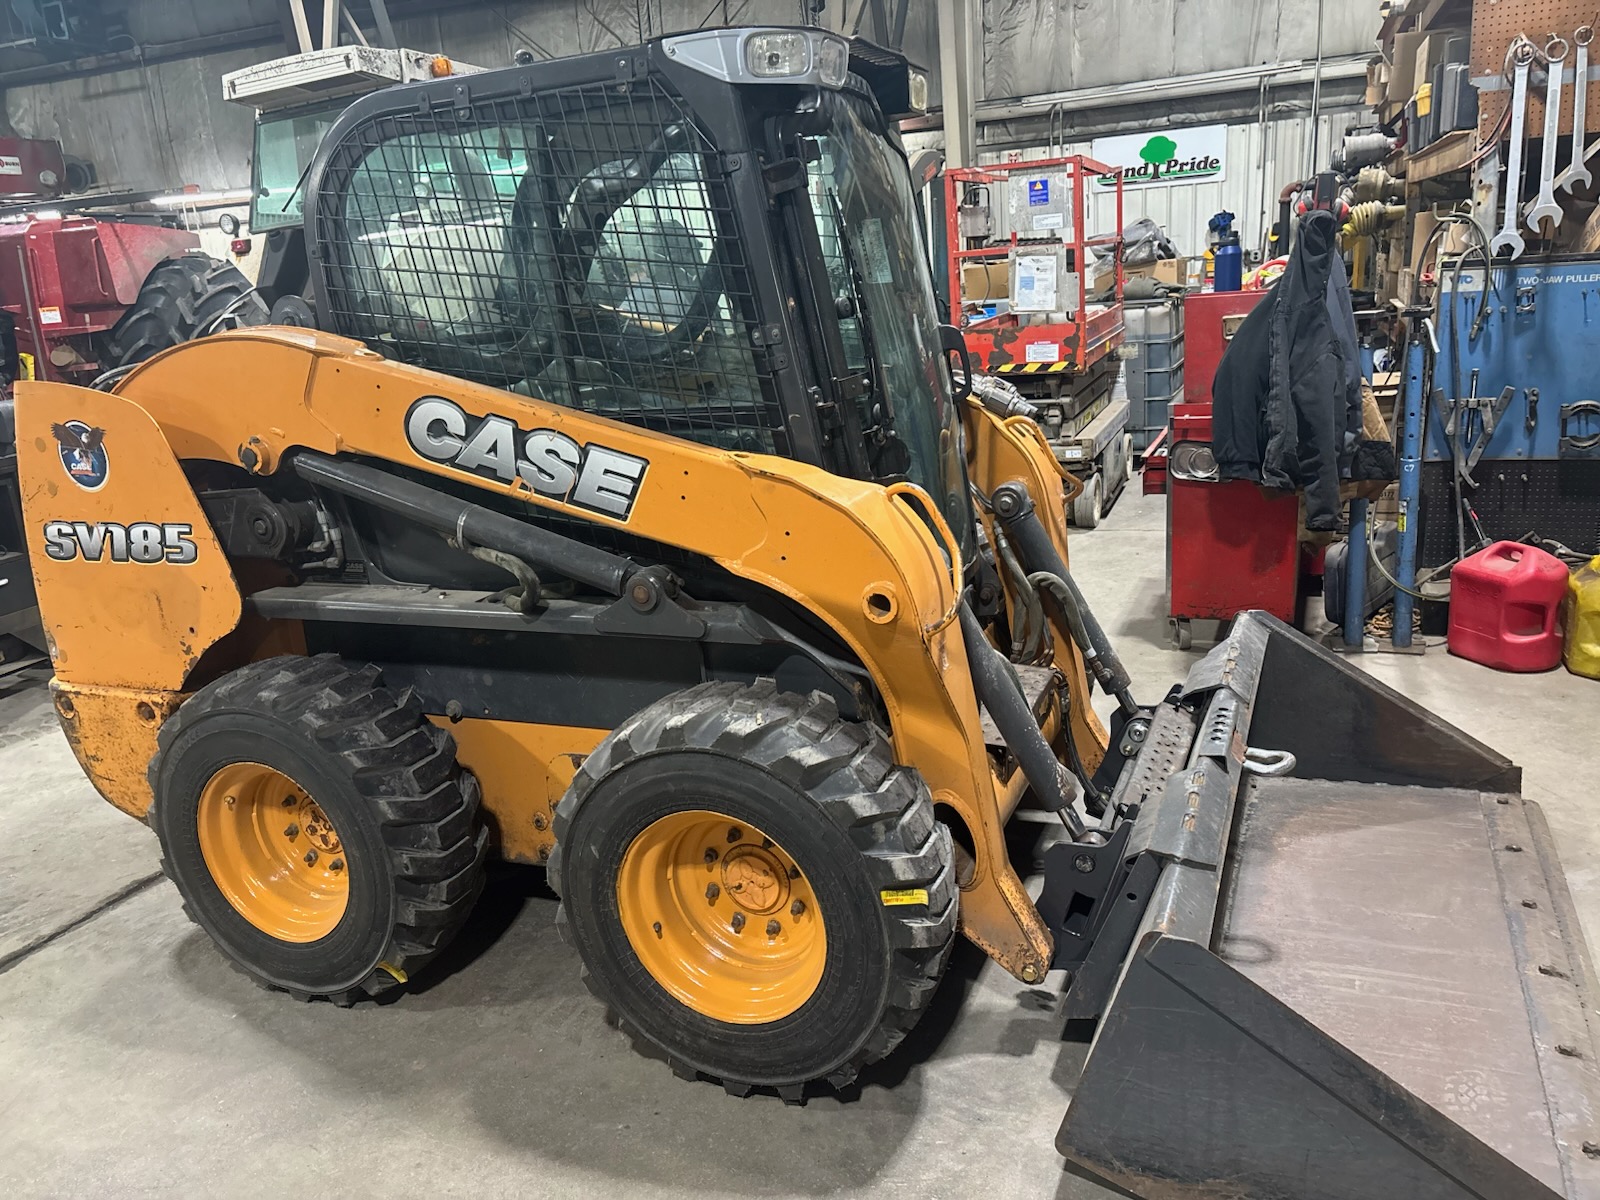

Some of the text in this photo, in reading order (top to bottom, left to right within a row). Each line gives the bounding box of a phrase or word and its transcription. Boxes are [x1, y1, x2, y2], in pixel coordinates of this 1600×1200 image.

[1165, 155, 1219, 173] Pride
[1516, 275, 1563, 285] TWO-JAW
[405, 397, 647, 520] CASE
[1404, 464, 1415, 472] C7
[44, 521, 198, 563] SV185
